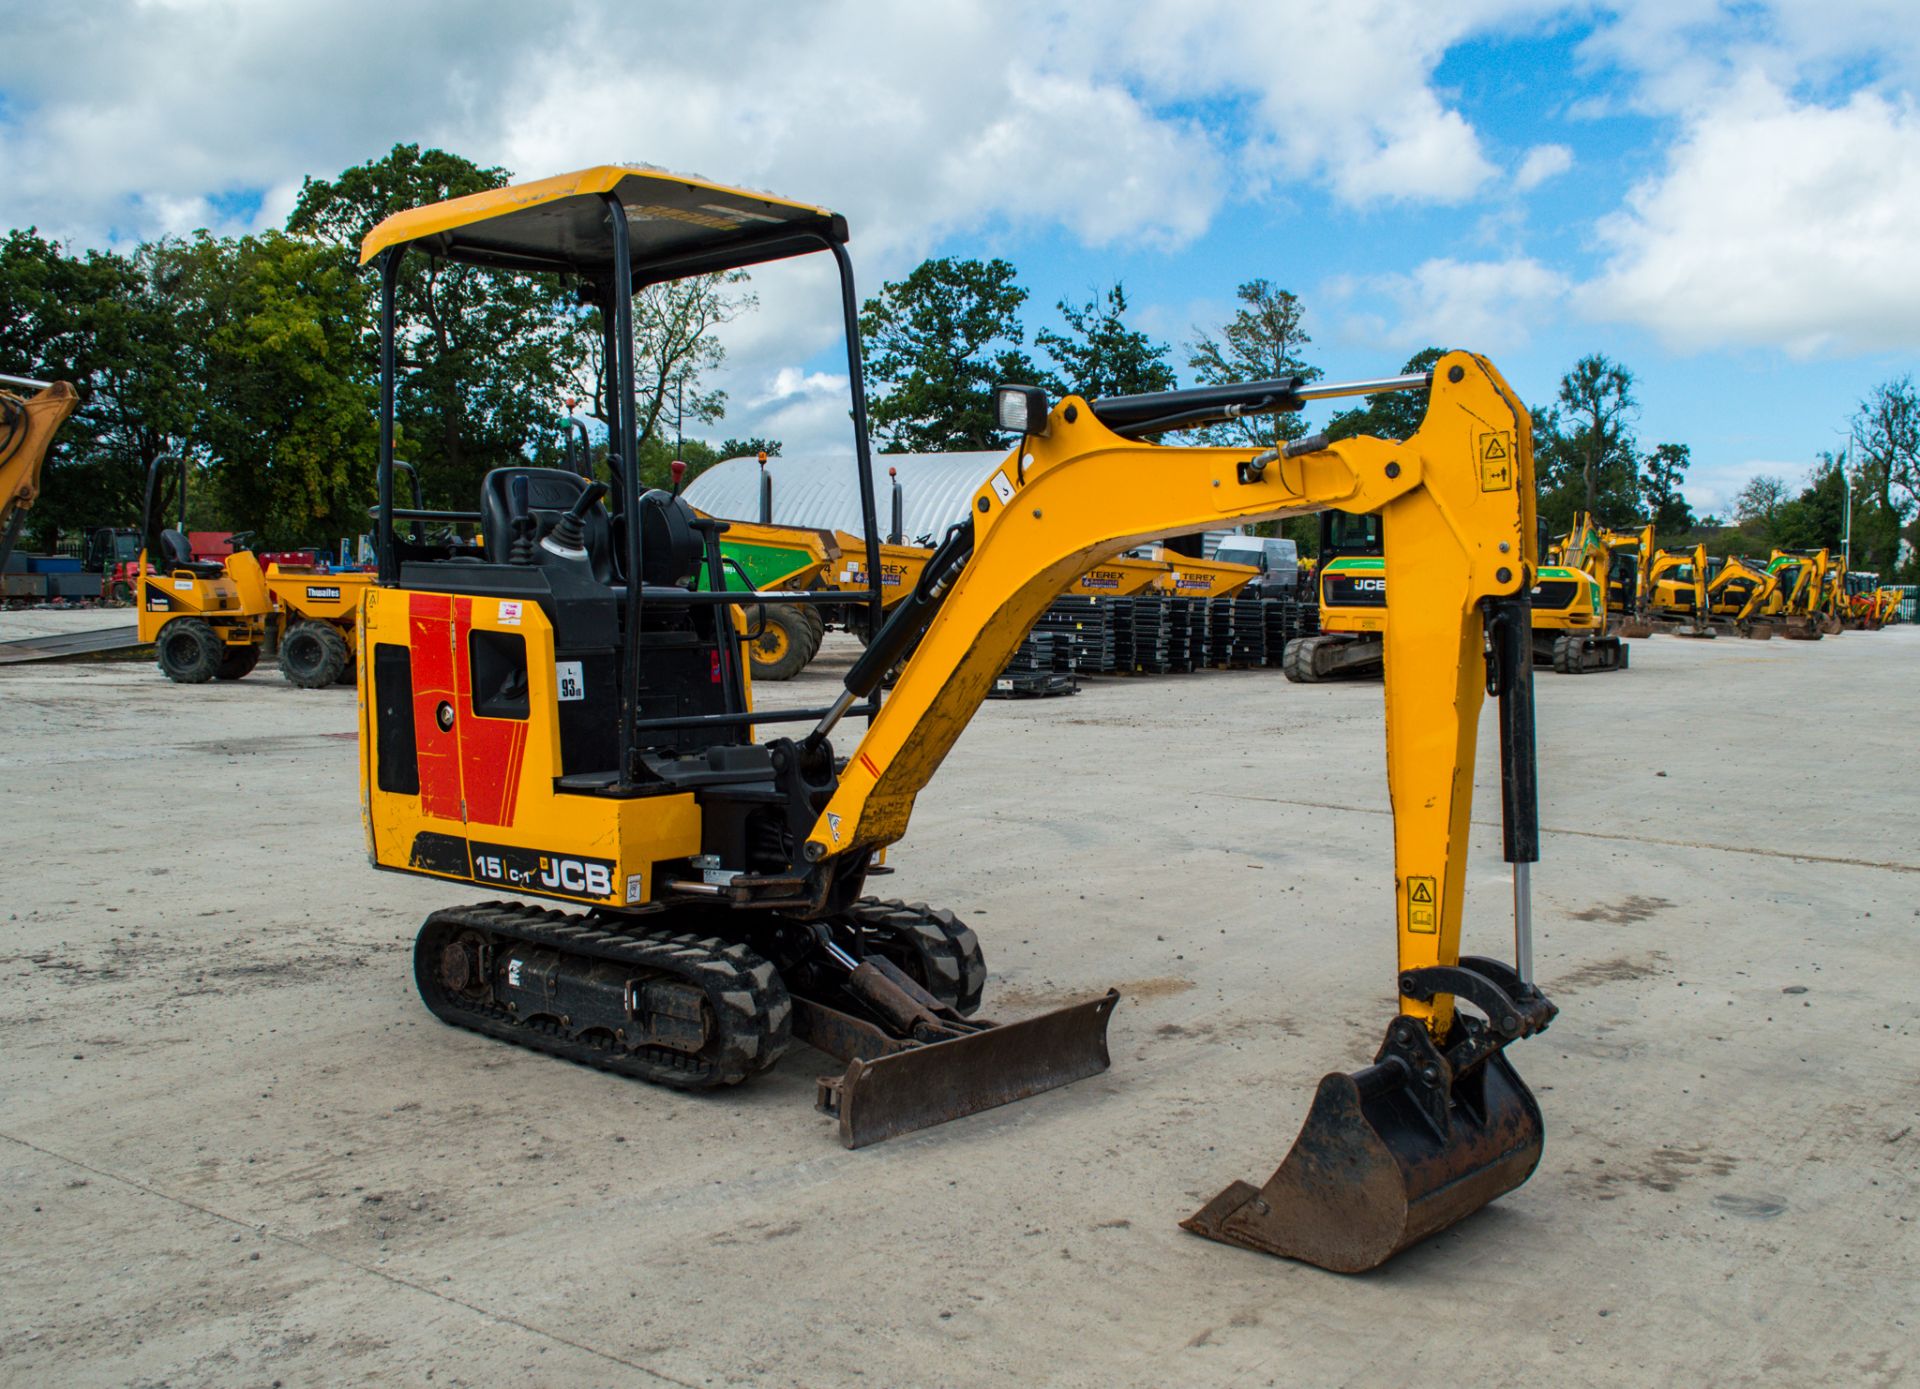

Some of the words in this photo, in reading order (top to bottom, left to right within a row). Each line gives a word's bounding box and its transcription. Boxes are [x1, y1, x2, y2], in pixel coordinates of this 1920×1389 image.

[862, 563, 907, 574] TREX
[1091, 571, 1124, 580] TEREX
[1183, 573, 1216, 581] TEREX
[308, 587, 339, 597] Thwaites
[562, 678, 575, 697] 93
[475, 855, 502, 878] 15
[540, 856, 612, 895] JCB
